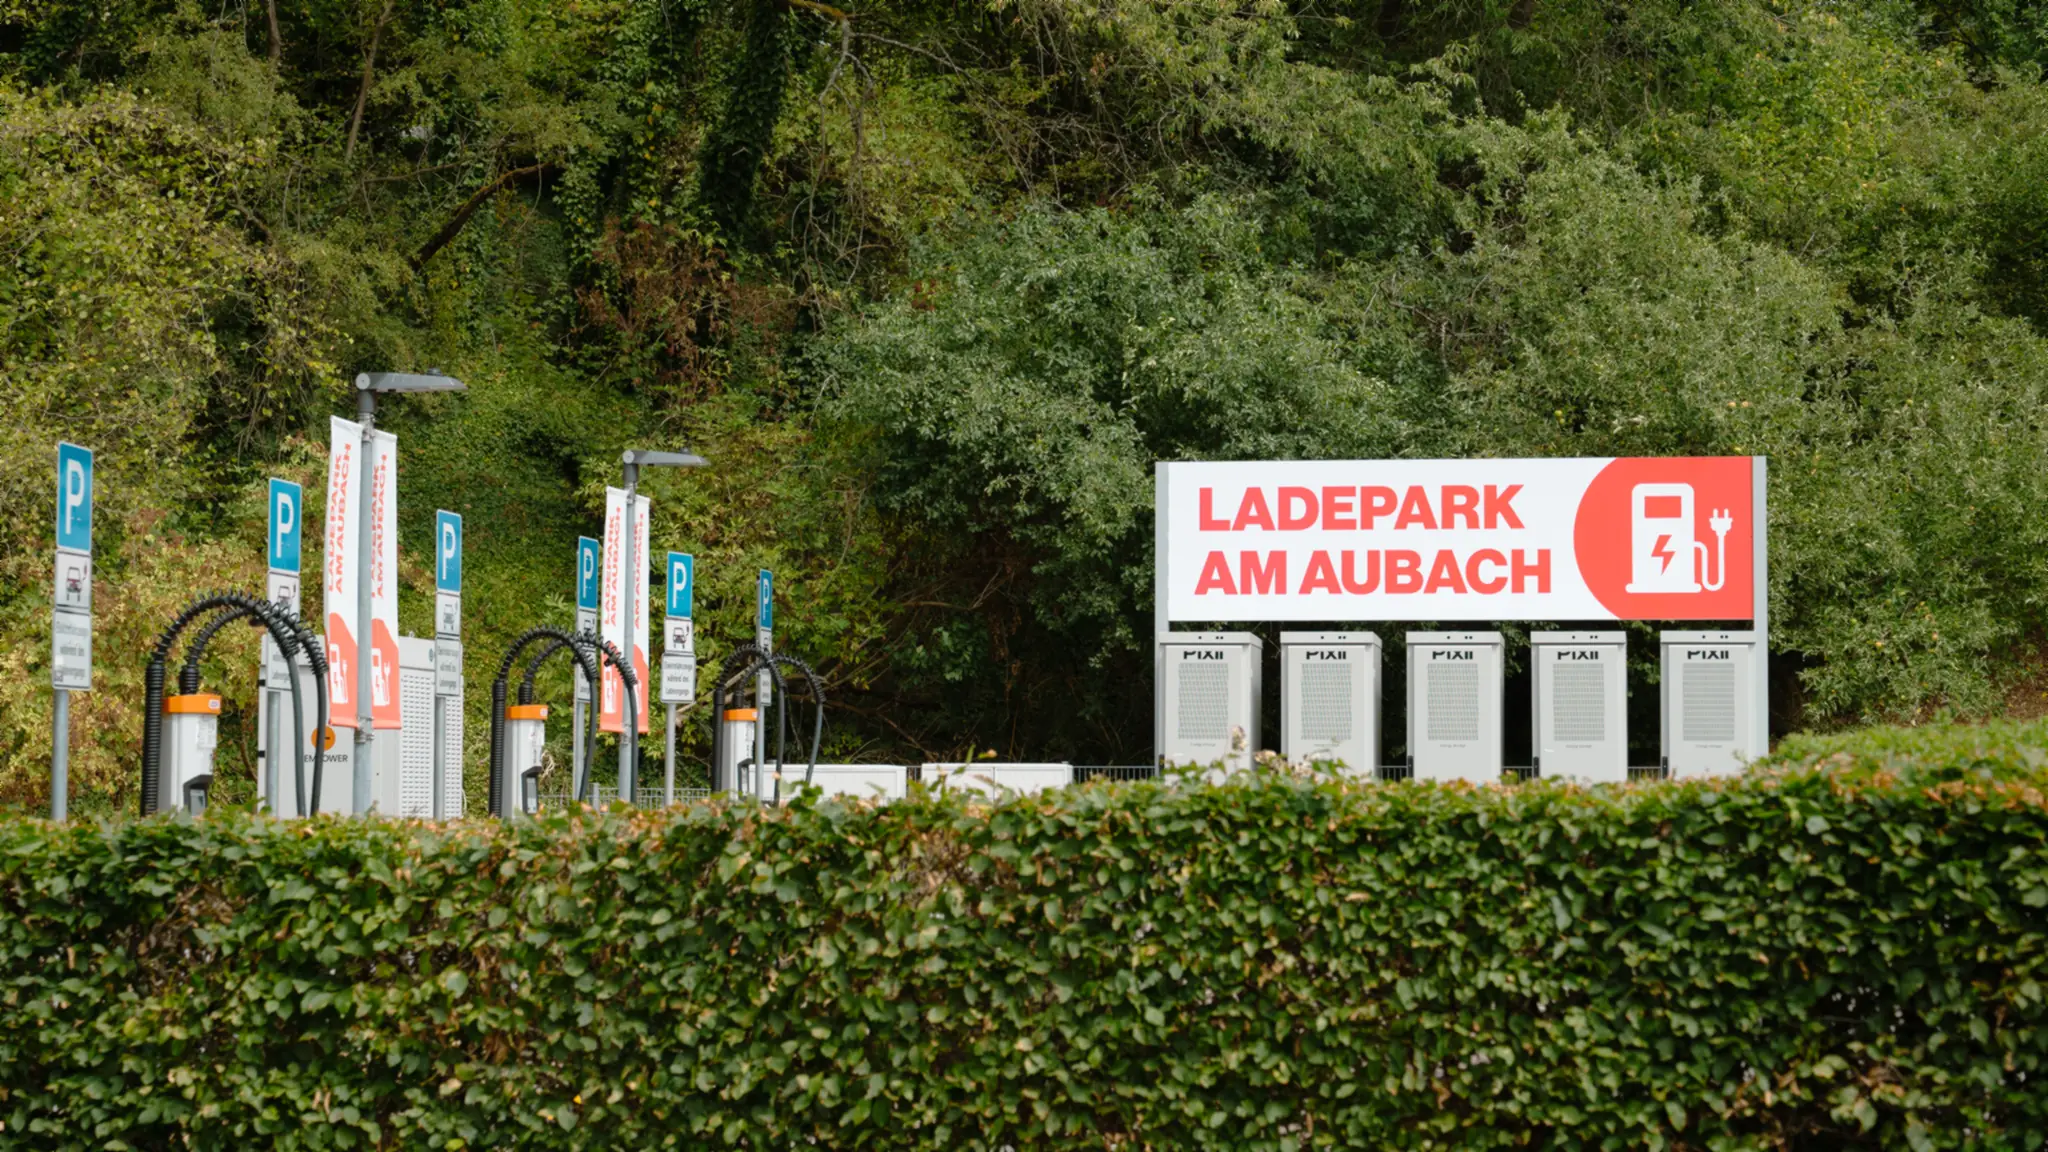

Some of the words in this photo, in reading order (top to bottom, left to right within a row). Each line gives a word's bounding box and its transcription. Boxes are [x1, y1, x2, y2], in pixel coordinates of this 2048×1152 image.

[65, 458, 84, 535] P
[337, 443, 352, 551] AUBACH
[1199, 484, 1524, 532] LADEPARK
[276, 492, 294, 558] P
[335, 555, 343, 595] AM
[442, 522, 456, 580] P
[583, 548, 594, 599] P
[1194, 550, 1287, 596] AM
[1299, 548, 1551, 595] AUBACH
[377, 561, 384, 598] AM
[673, 561, 687, 608] P
[763, 578, 770, 621] P
[611, 594, 617, 628] AM
[303, 754, 348, 763] EMOWER
